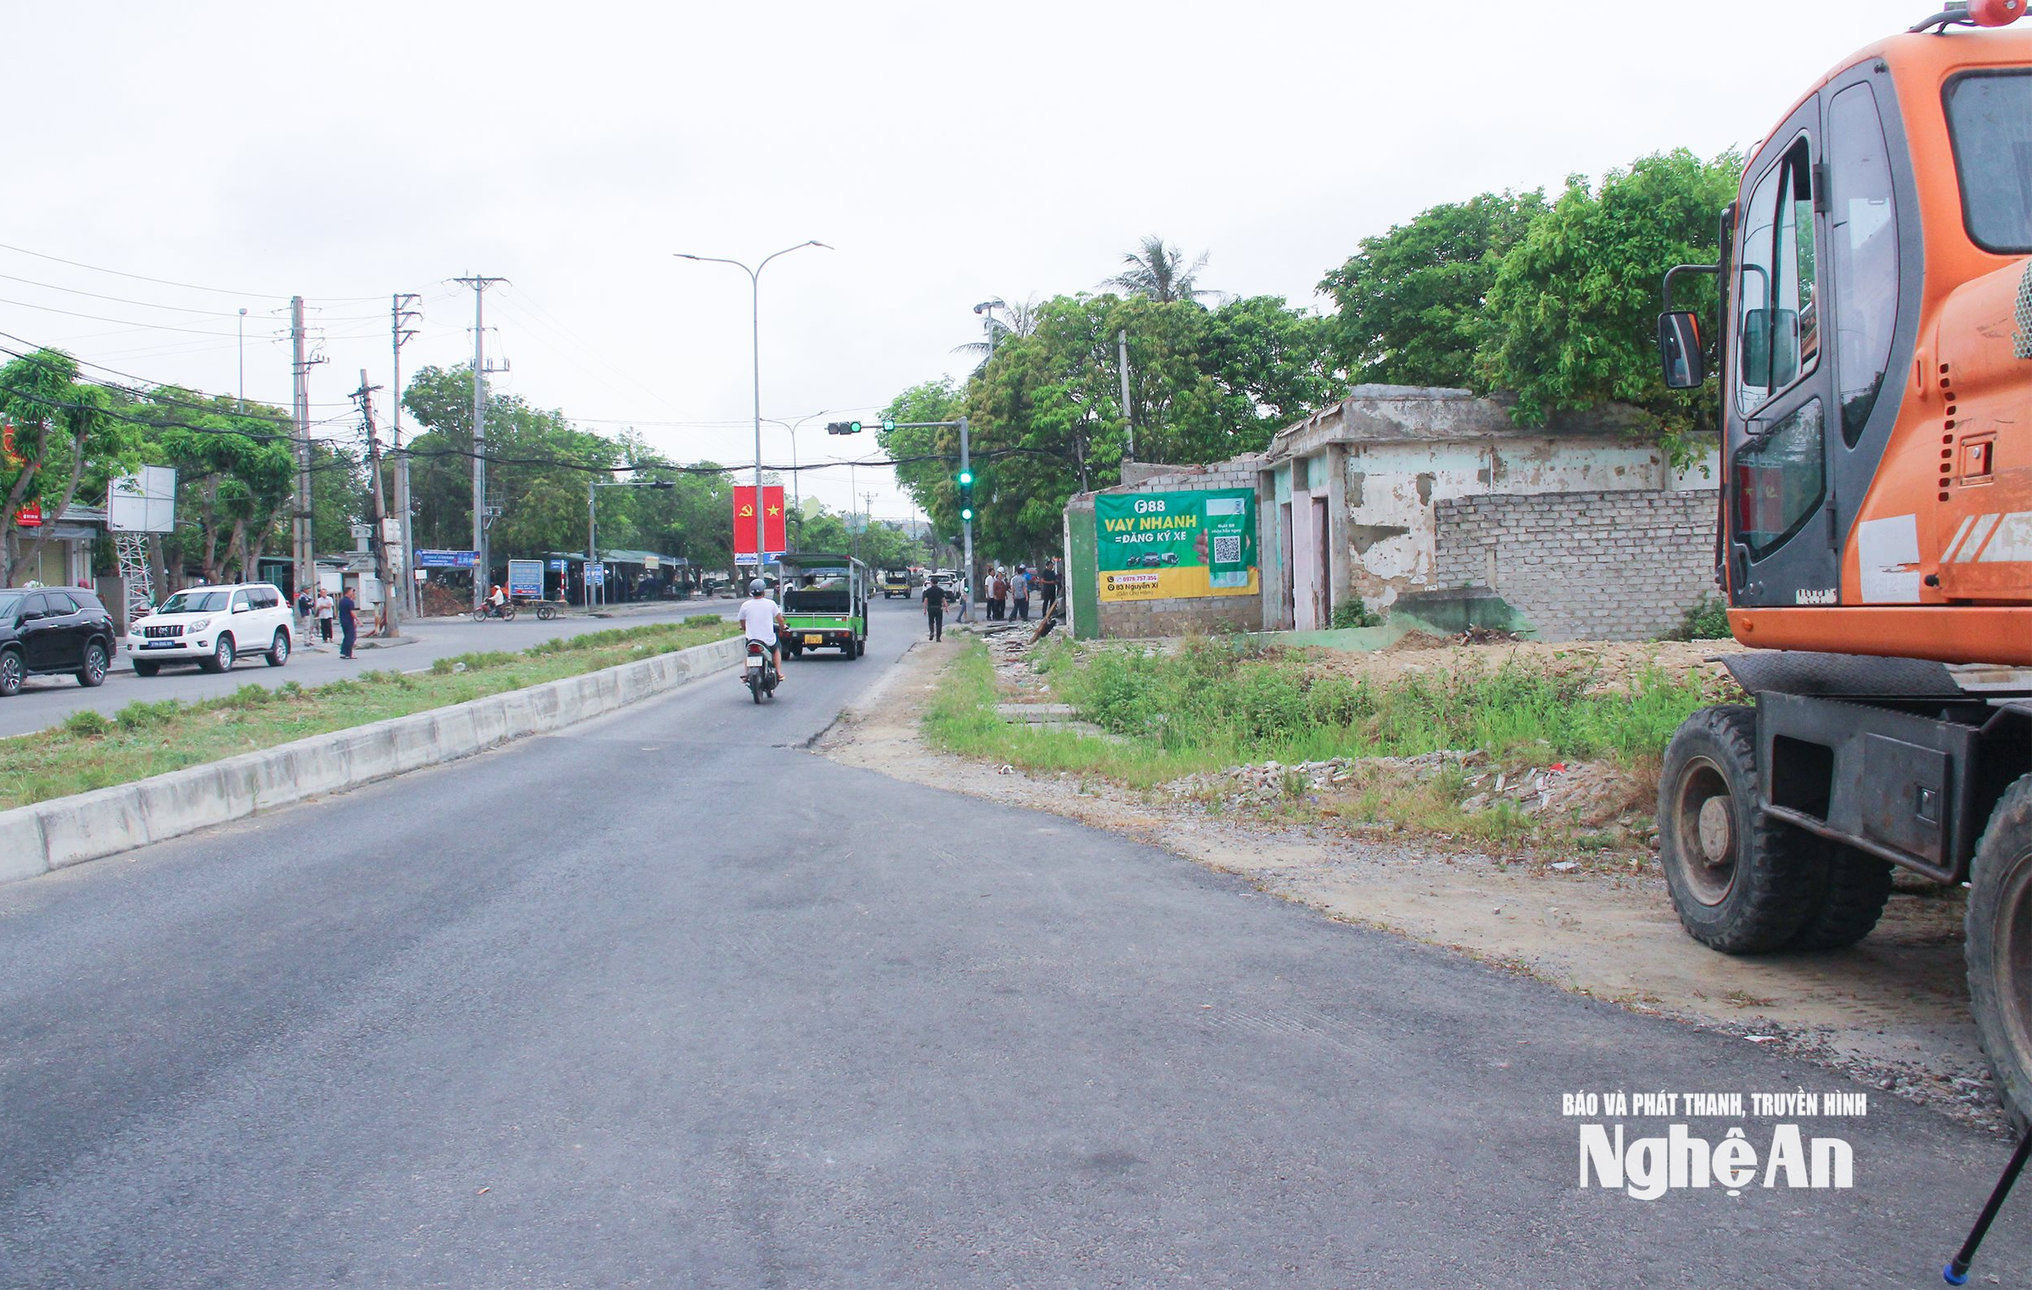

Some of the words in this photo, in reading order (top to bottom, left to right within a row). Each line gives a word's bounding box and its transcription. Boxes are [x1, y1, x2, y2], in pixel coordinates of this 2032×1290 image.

[1134, 499, 1166, 514] F88
[1104, 518, 1135, 532] VAY
[1139, 514, 1197, 531] NHANH
[1156, 530, 1171, 542] KÝ
[1173, 531, 1187, 541] XE
[1125, 582, 1150, 591] Nguyễn
